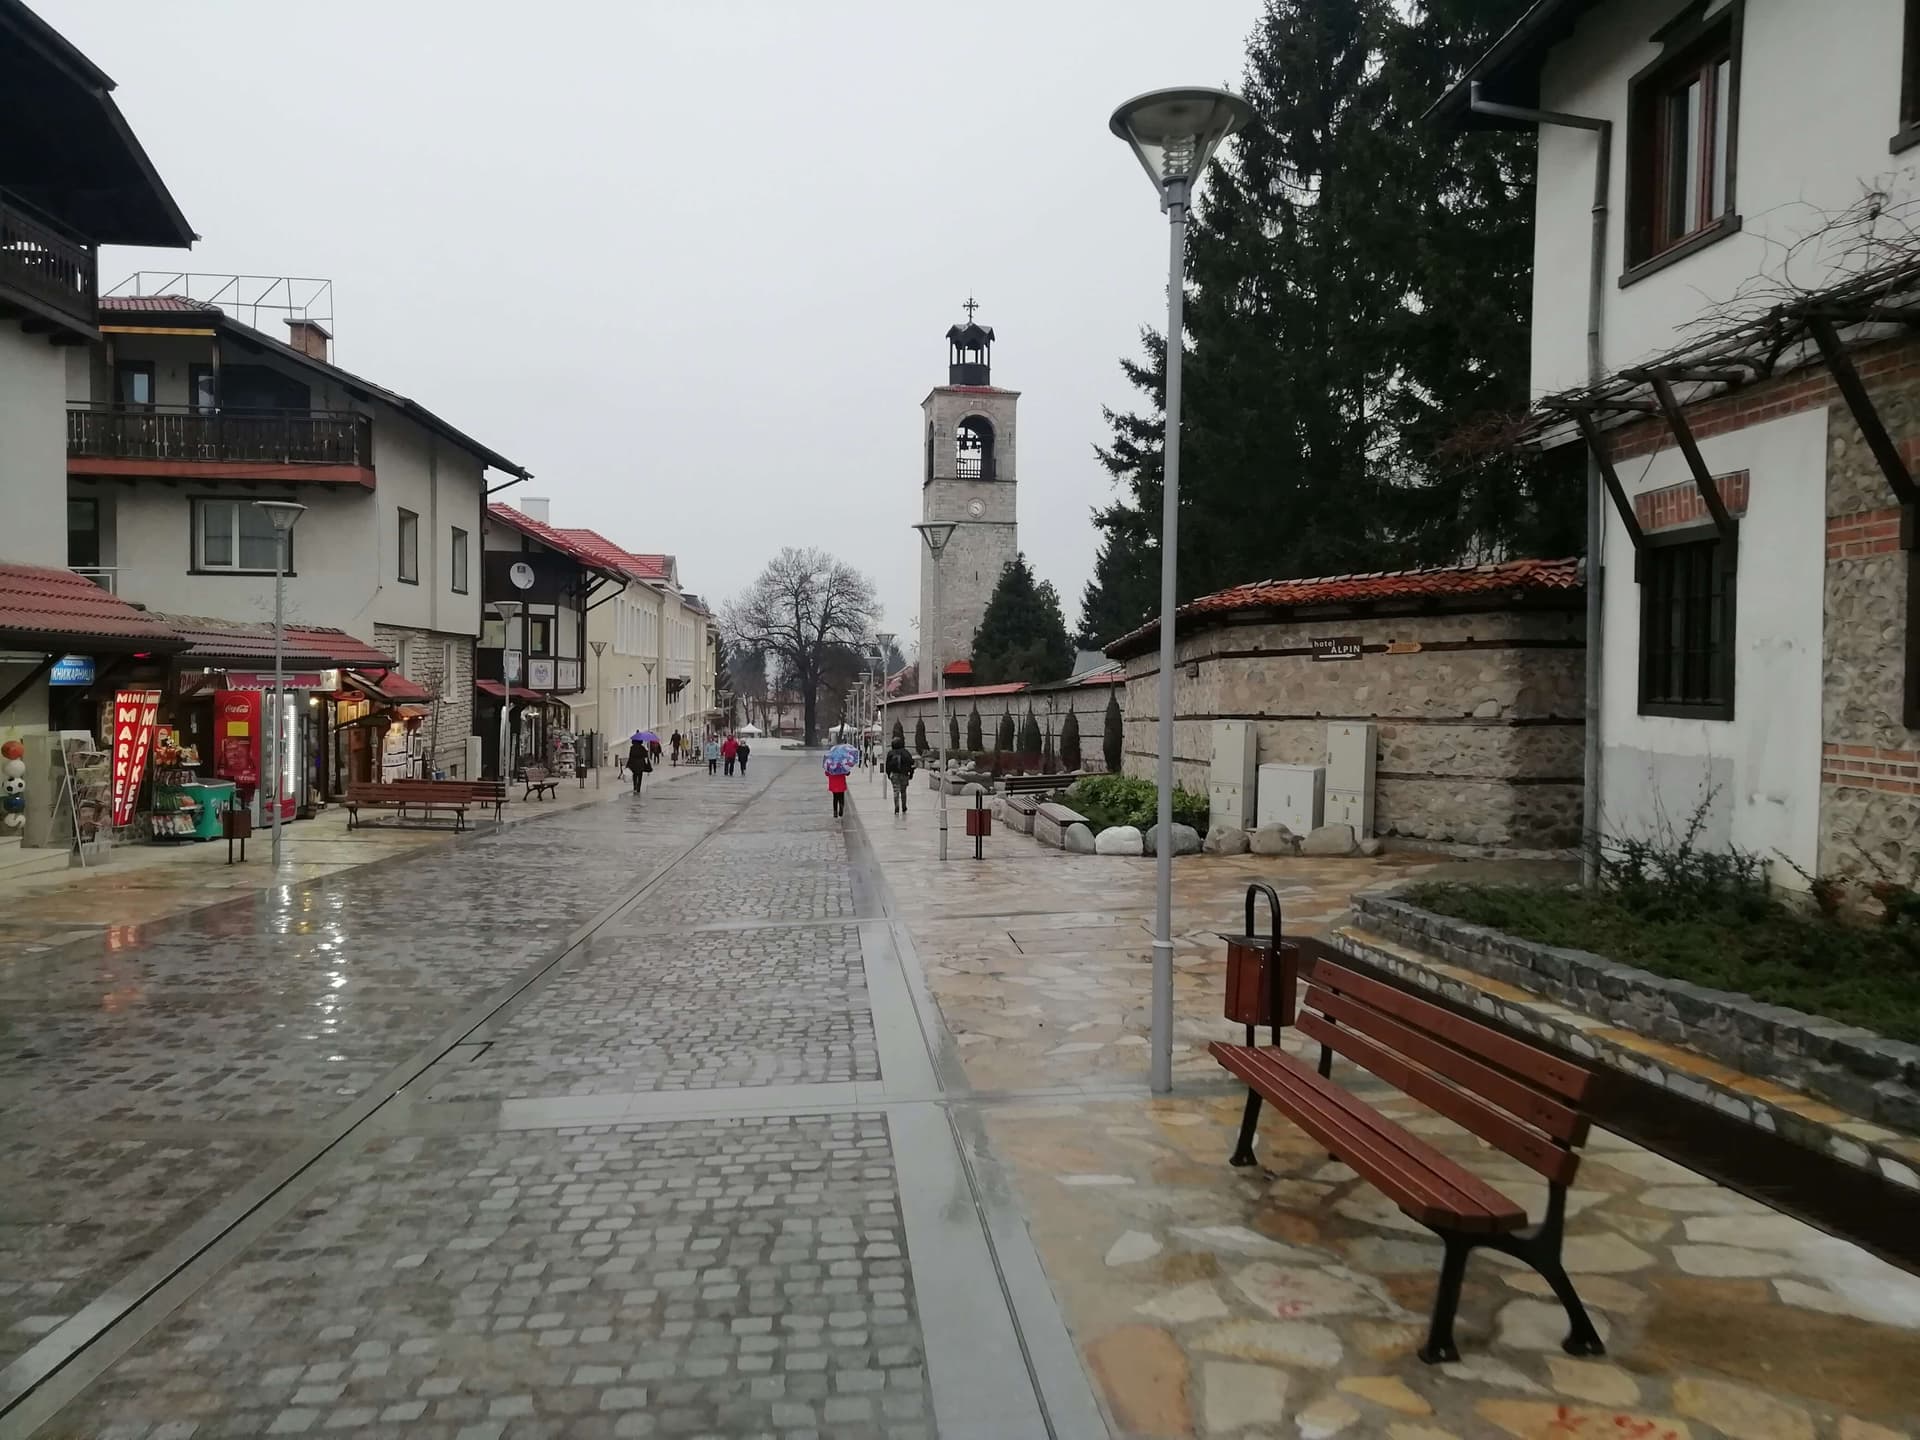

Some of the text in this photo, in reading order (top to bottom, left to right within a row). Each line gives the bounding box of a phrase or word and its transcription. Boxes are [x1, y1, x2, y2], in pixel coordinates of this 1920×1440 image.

[1314, 639, 1335, 648] hotel
[1330, 645, 1361, 654] ALPIN
[116, 693, 145, 703] MINI
[114, 707, 137, 812] MARKET
